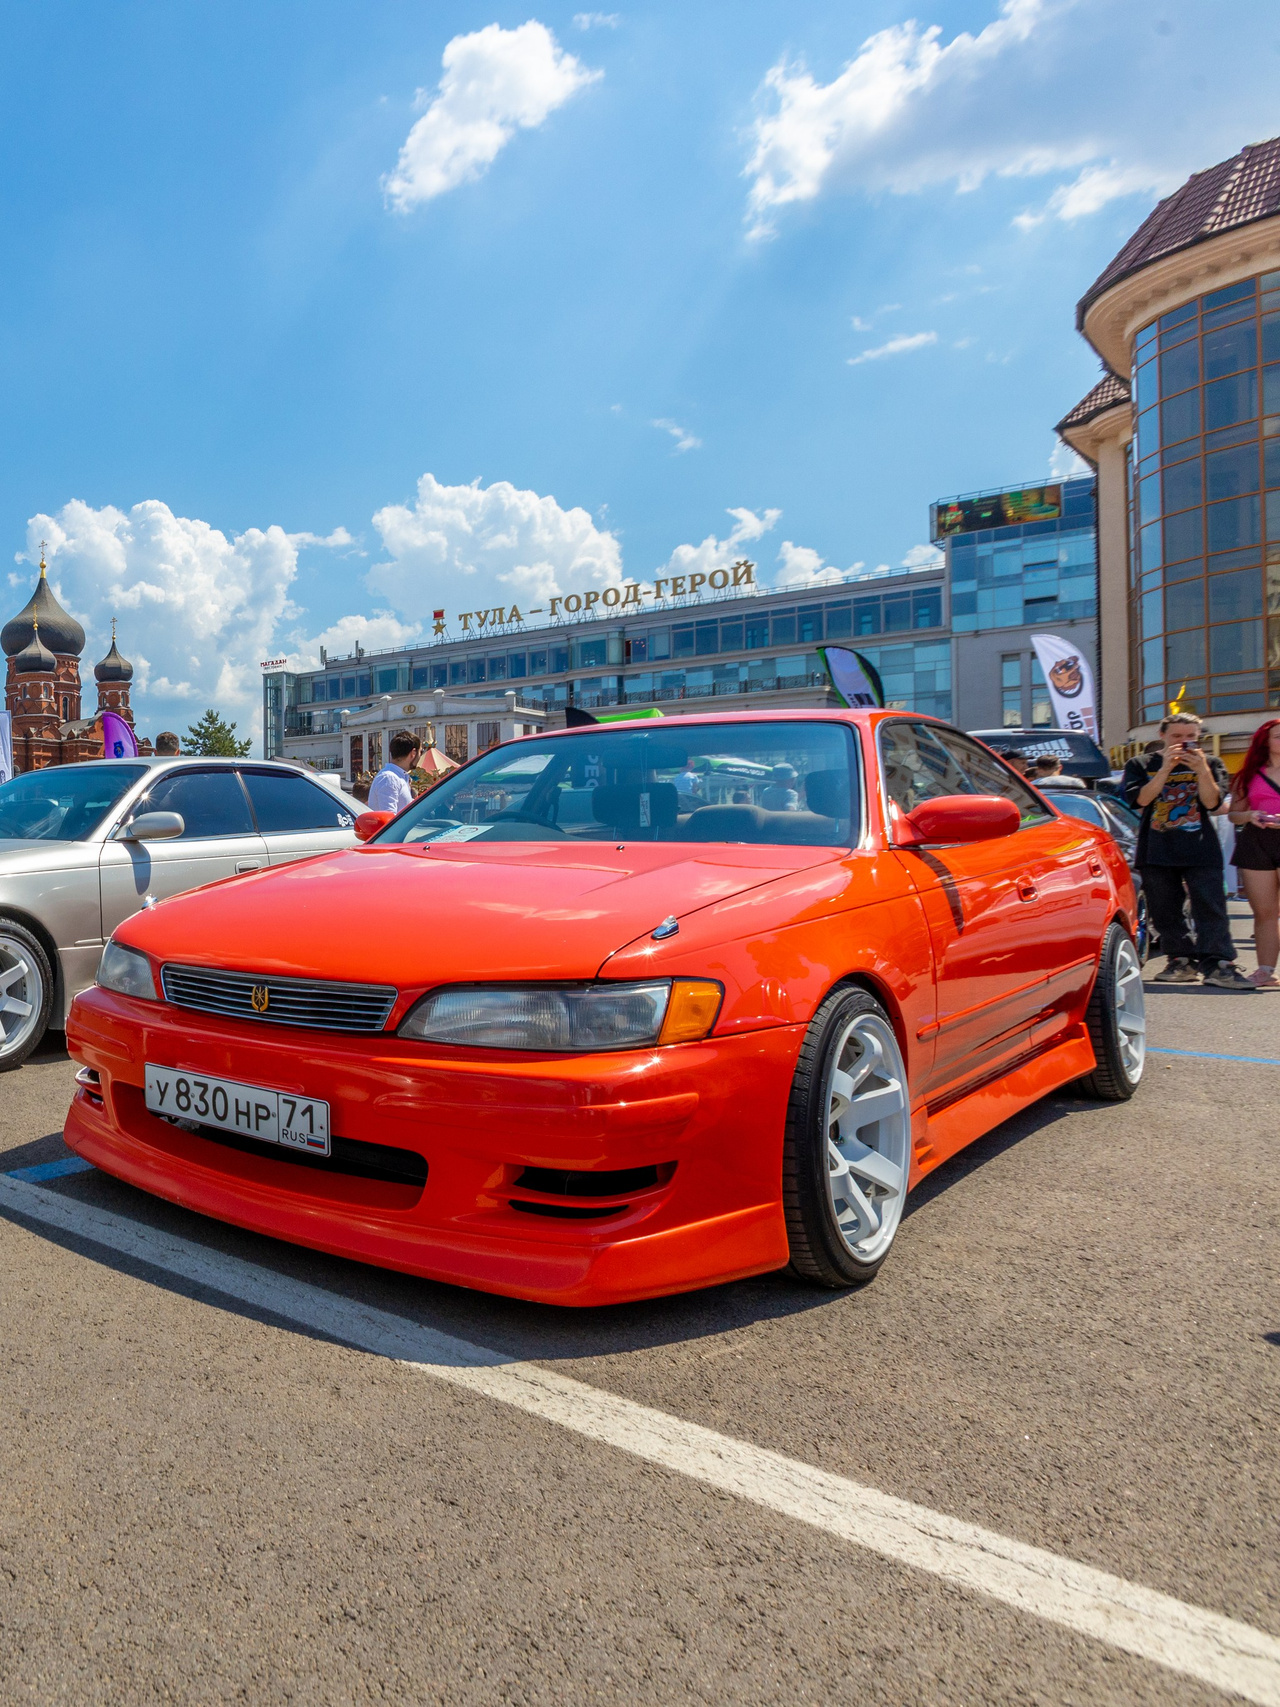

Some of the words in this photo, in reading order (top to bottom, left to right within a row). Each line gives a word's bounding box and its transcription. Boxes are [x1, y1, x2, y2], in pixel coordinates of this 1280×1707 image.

[458, 604, 523, 630] ТУЛА
[549, 560, 755, 616] ГОРОД-ГЕРОЙ
[282, 1098, 314, 1134] 71
[282, 1128, 306, 1144] RUS
